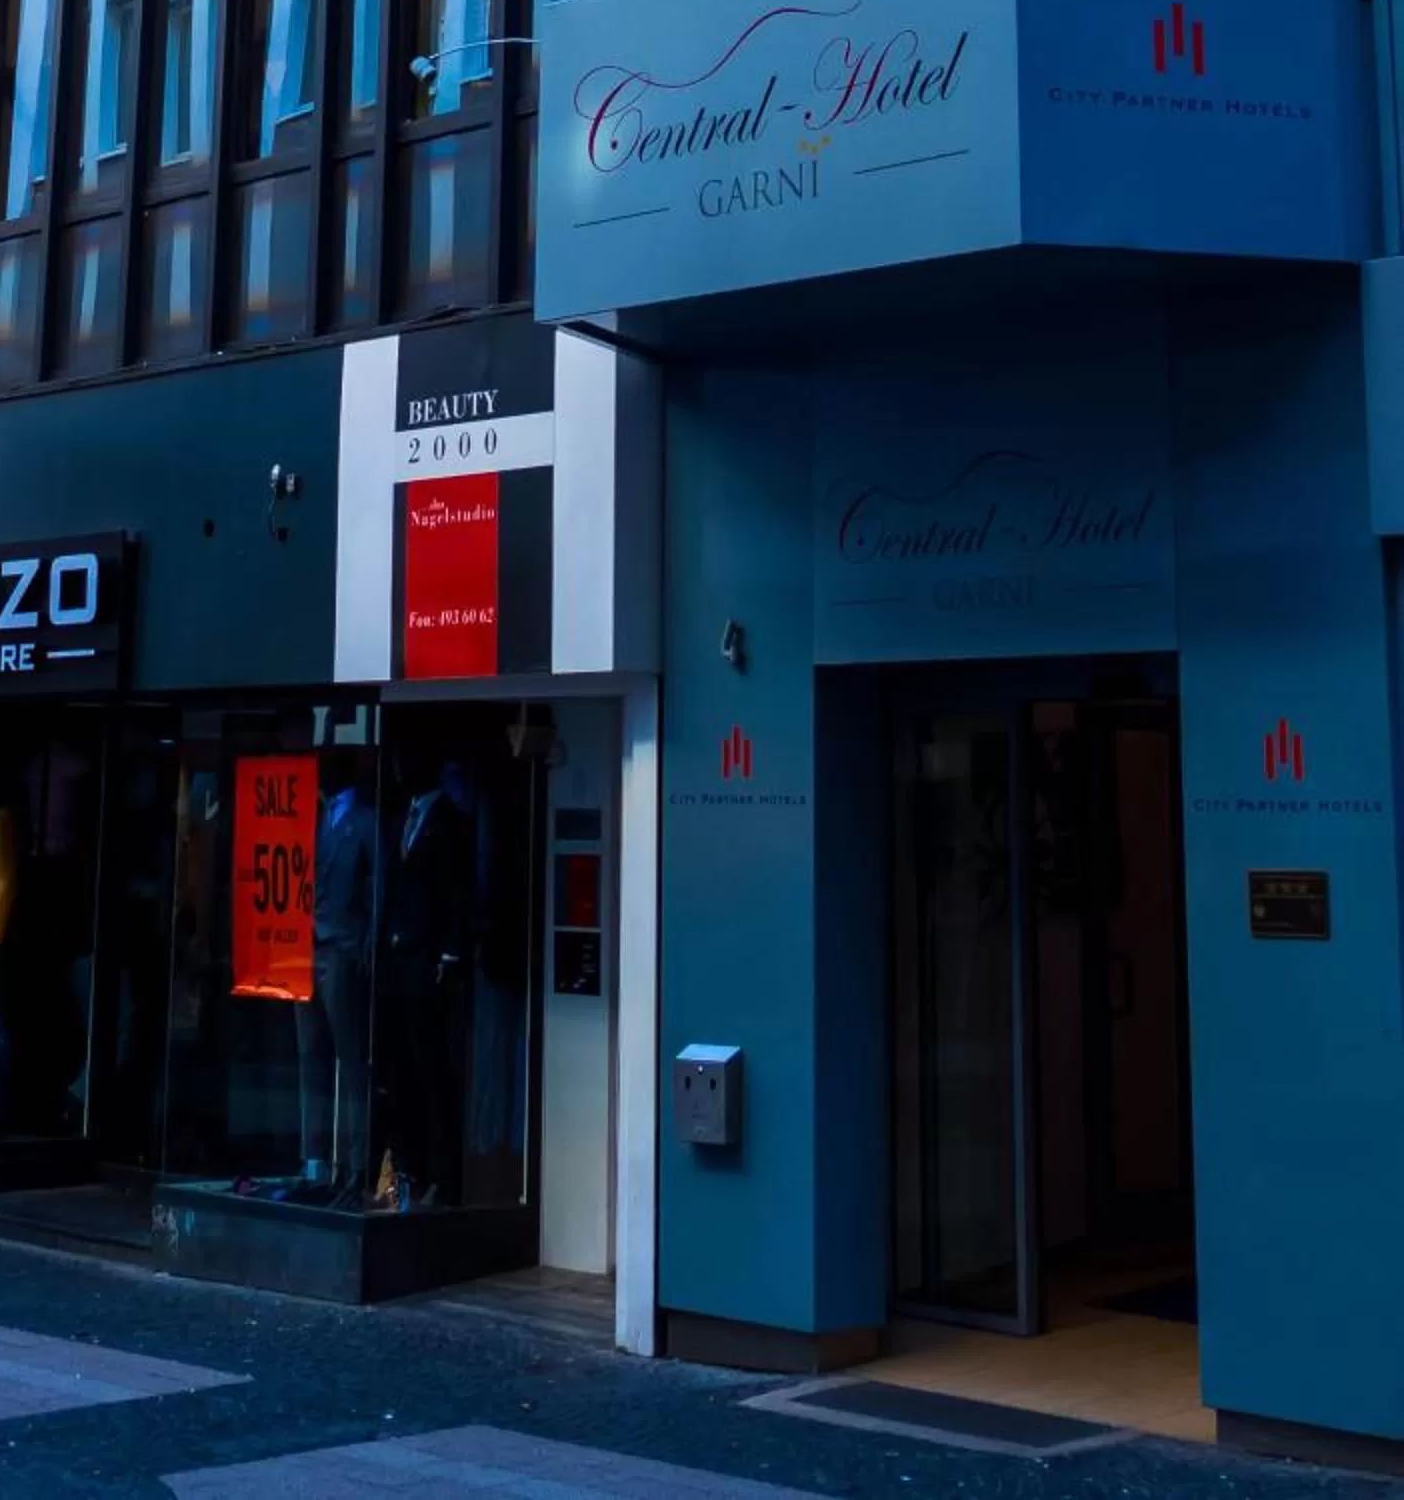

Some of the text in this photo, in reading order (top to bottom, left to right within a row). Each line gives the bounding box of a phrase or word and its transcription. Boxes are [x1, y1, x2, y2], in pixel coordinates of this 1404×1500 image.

[698, 159, 819, 218] GARNI
[407, 388, 499, 425] BEAUTY
[407, 427, 498, 464] 2000
[410, 503, 495, 531] Nagelstudio
[932, 576, 1035, 612] GARNI
[254, 774, 299, 819] SALE
[251, 842, 313, 916] 50%
